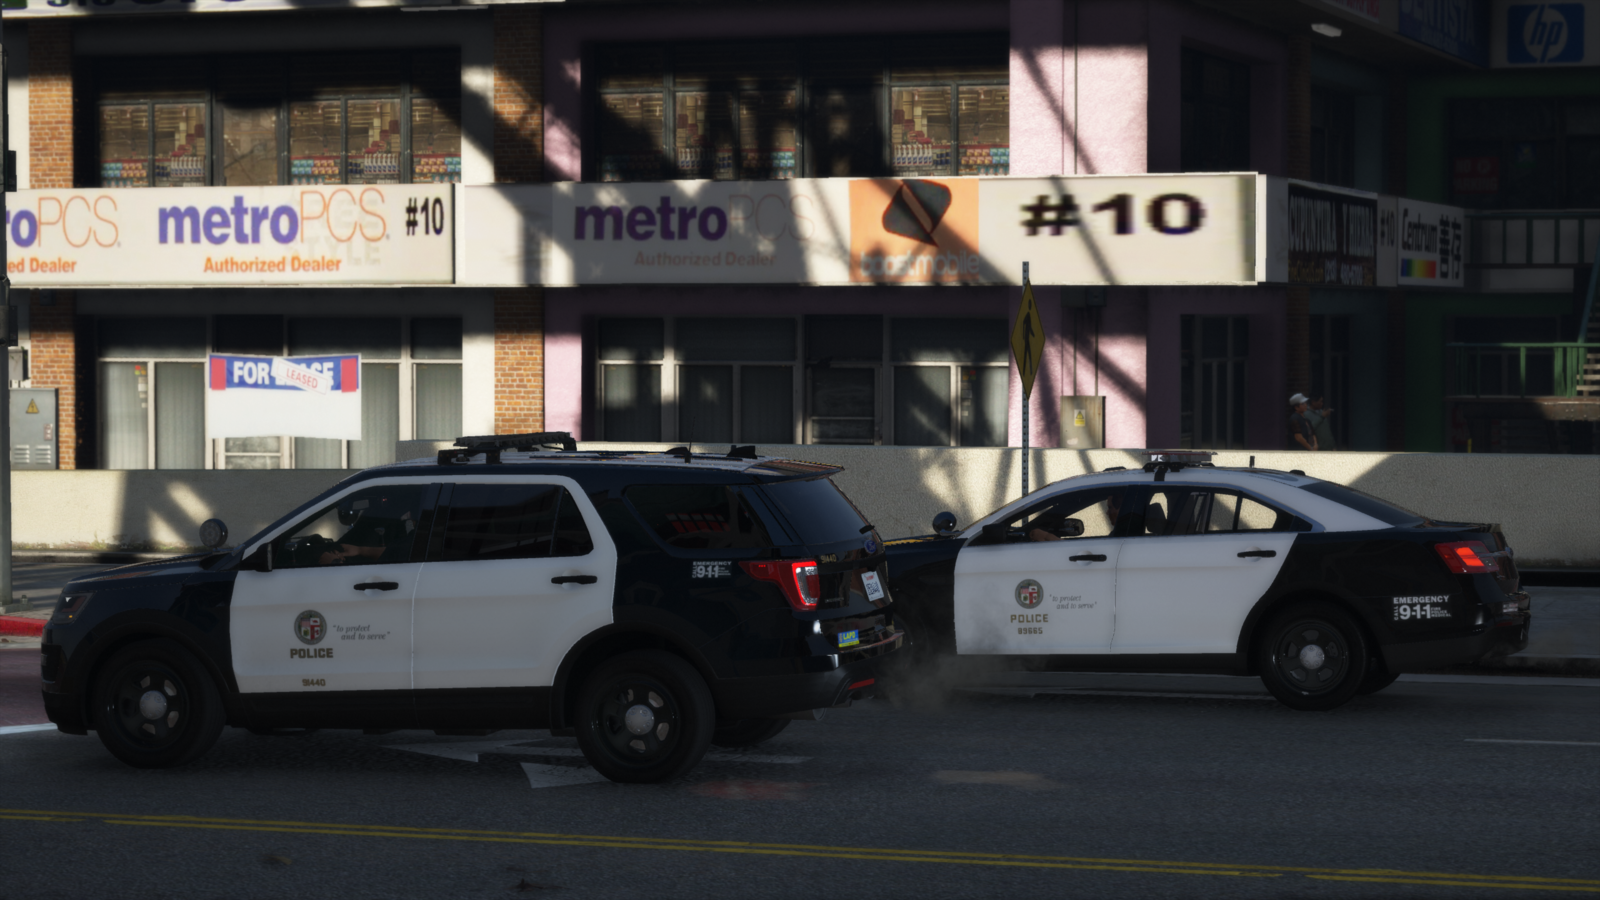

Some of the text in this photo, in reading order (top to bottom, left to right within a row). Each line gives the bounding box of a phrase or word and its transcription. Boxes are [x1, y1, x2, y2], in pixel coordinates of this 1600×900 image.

[1529, 4, 1564, 63] hp
[158, 187, 387, 245] metroPCS
[405, 197, 444, 236] #10
[574, 193, 816, 242] metroPCS
[1020, 193, 1207, 236] #10
[1402, 207, 1438, 254] Centrum
[29, 257, 78, 274] Dealer
[203, 254, 343, 273] Authorized Dealer
[634, 250, 777, 267] Authorized Dealer
[232, 360, 271, 386] FOR
[286, 367, 319, 389] LEASED
[1056, 602, 1070, 610] and
[1060, 595, 1082, 604] protect
[1393, 595, 1450, 605] EMERGENCY
[1010, 614, 1049, 624] POLICE
[341, 632, 356, 641] and
[357, 632, 366, 641] to
[345, 624, 371, 634] protect
[290, 648, 334, 659] POLICE
